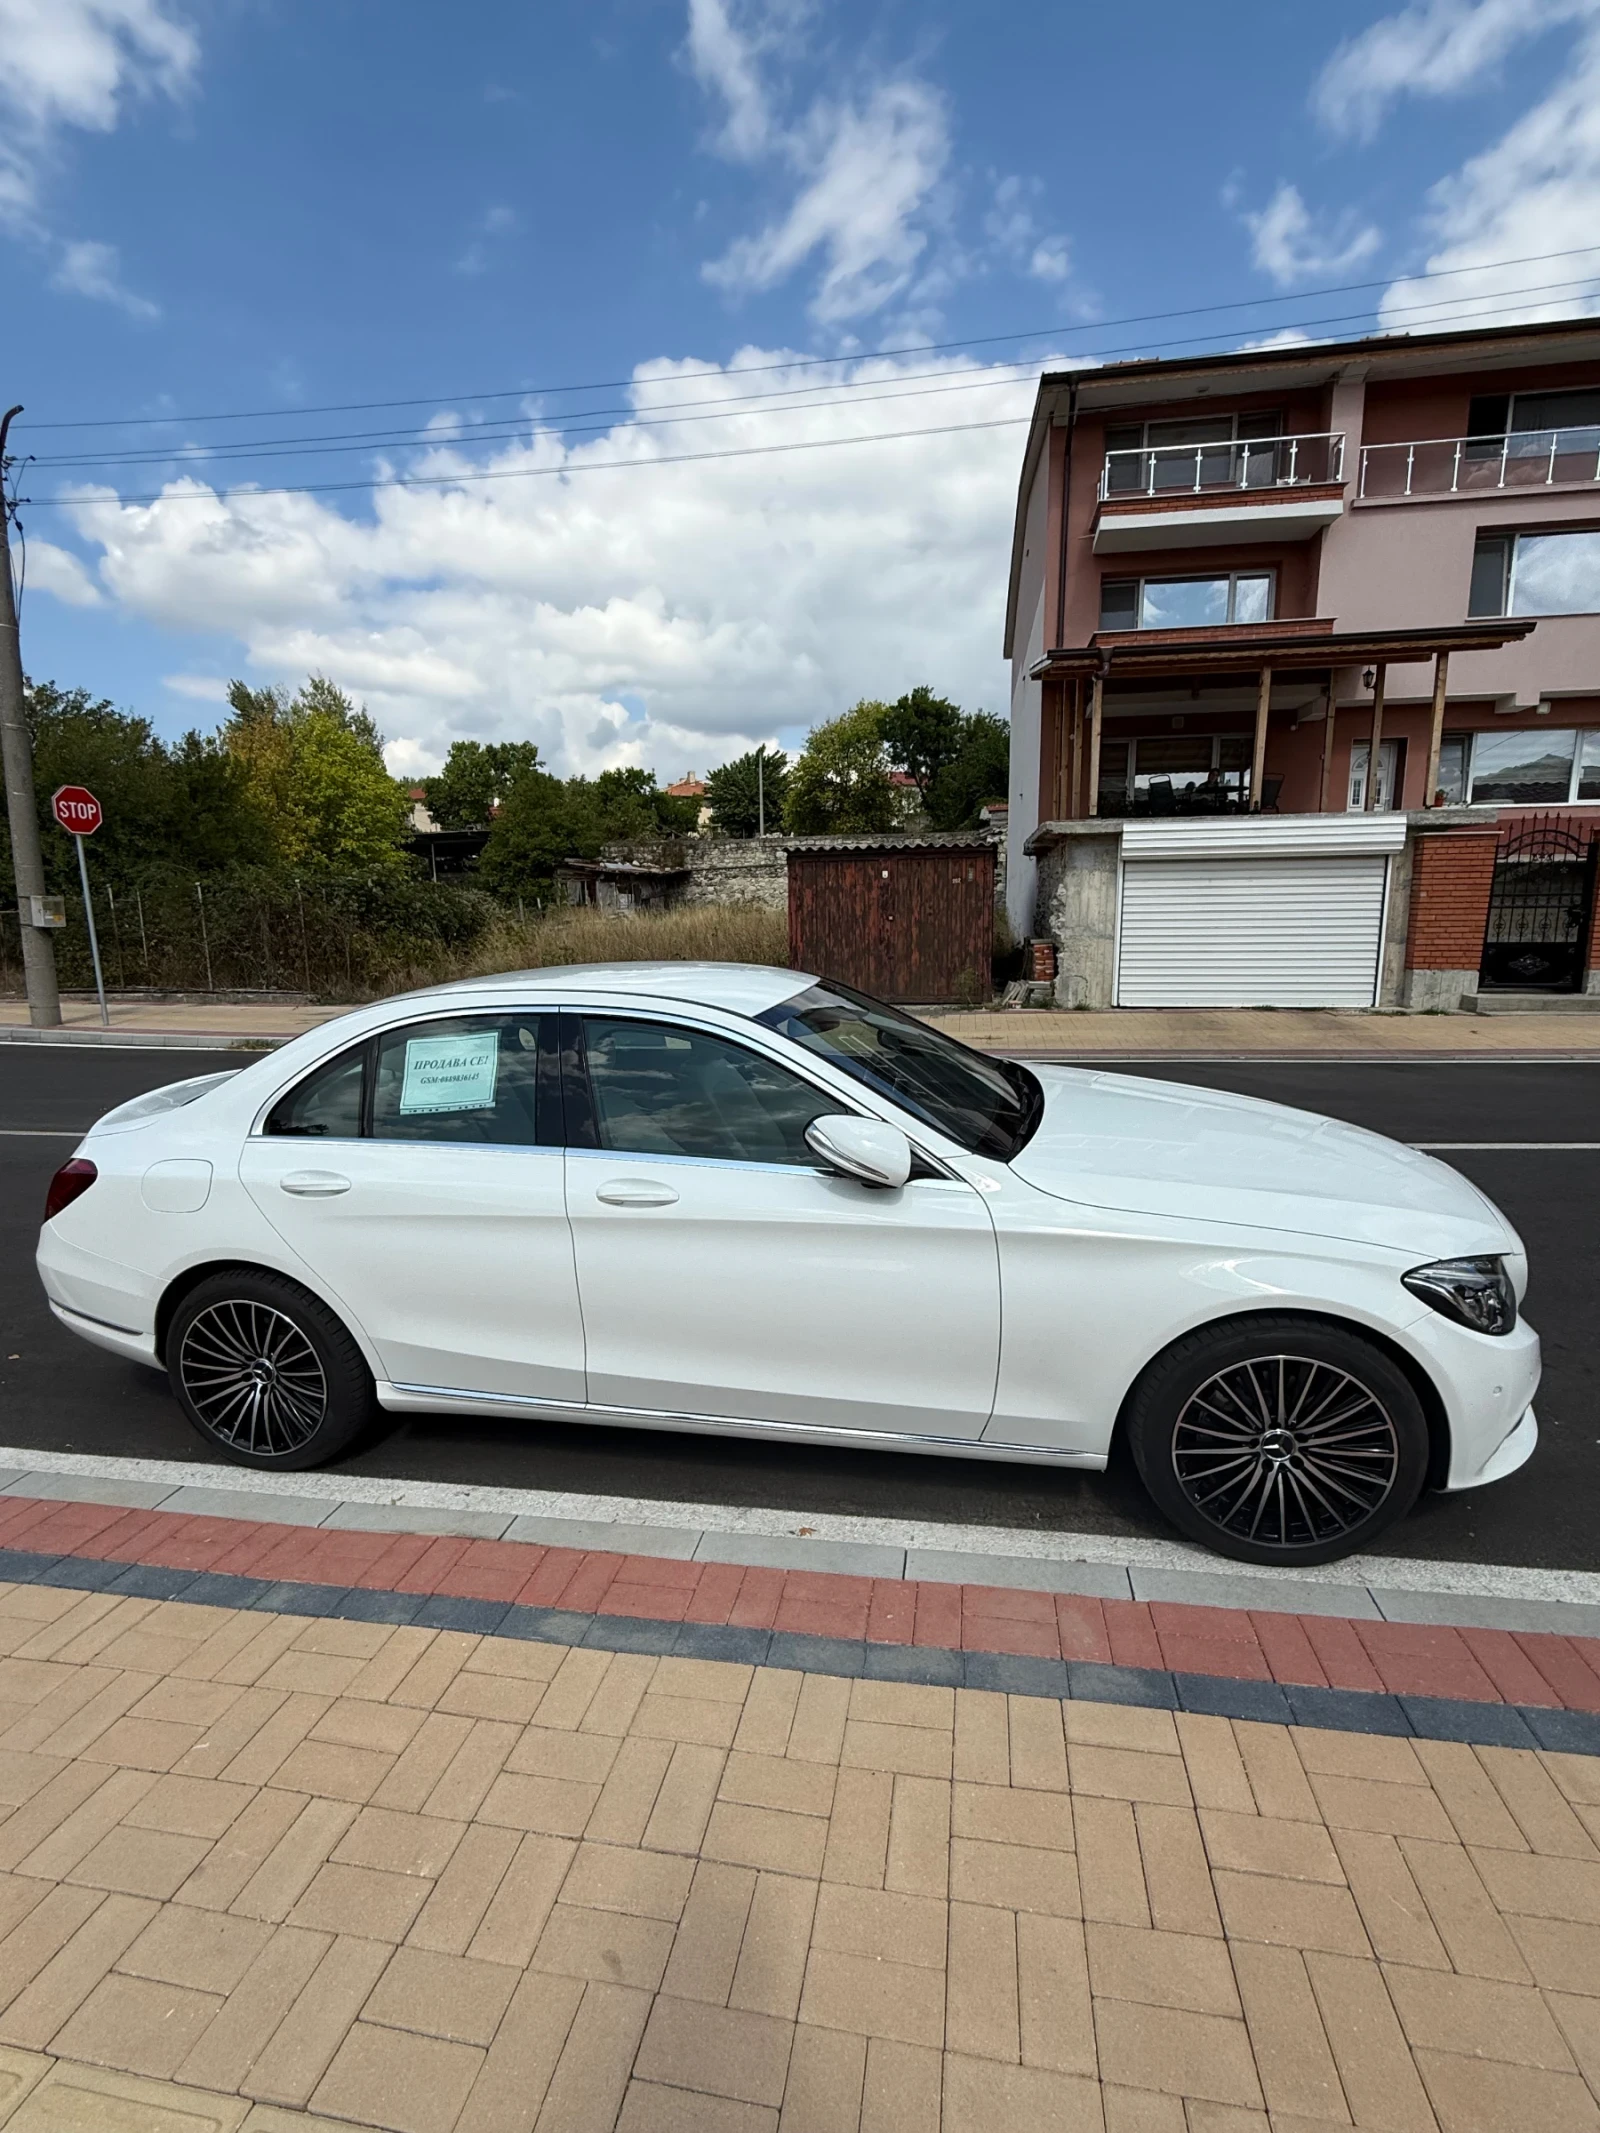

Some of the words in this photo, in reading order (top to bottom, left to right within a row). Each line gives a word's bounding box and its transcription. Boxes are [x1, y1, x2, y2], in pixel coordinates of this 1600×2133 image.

[59, 801, 97, 820] STOP
[414, 1057, 467, 1070] ПРОДАВА
[470, 1055, 489, 1066] СЕ!
